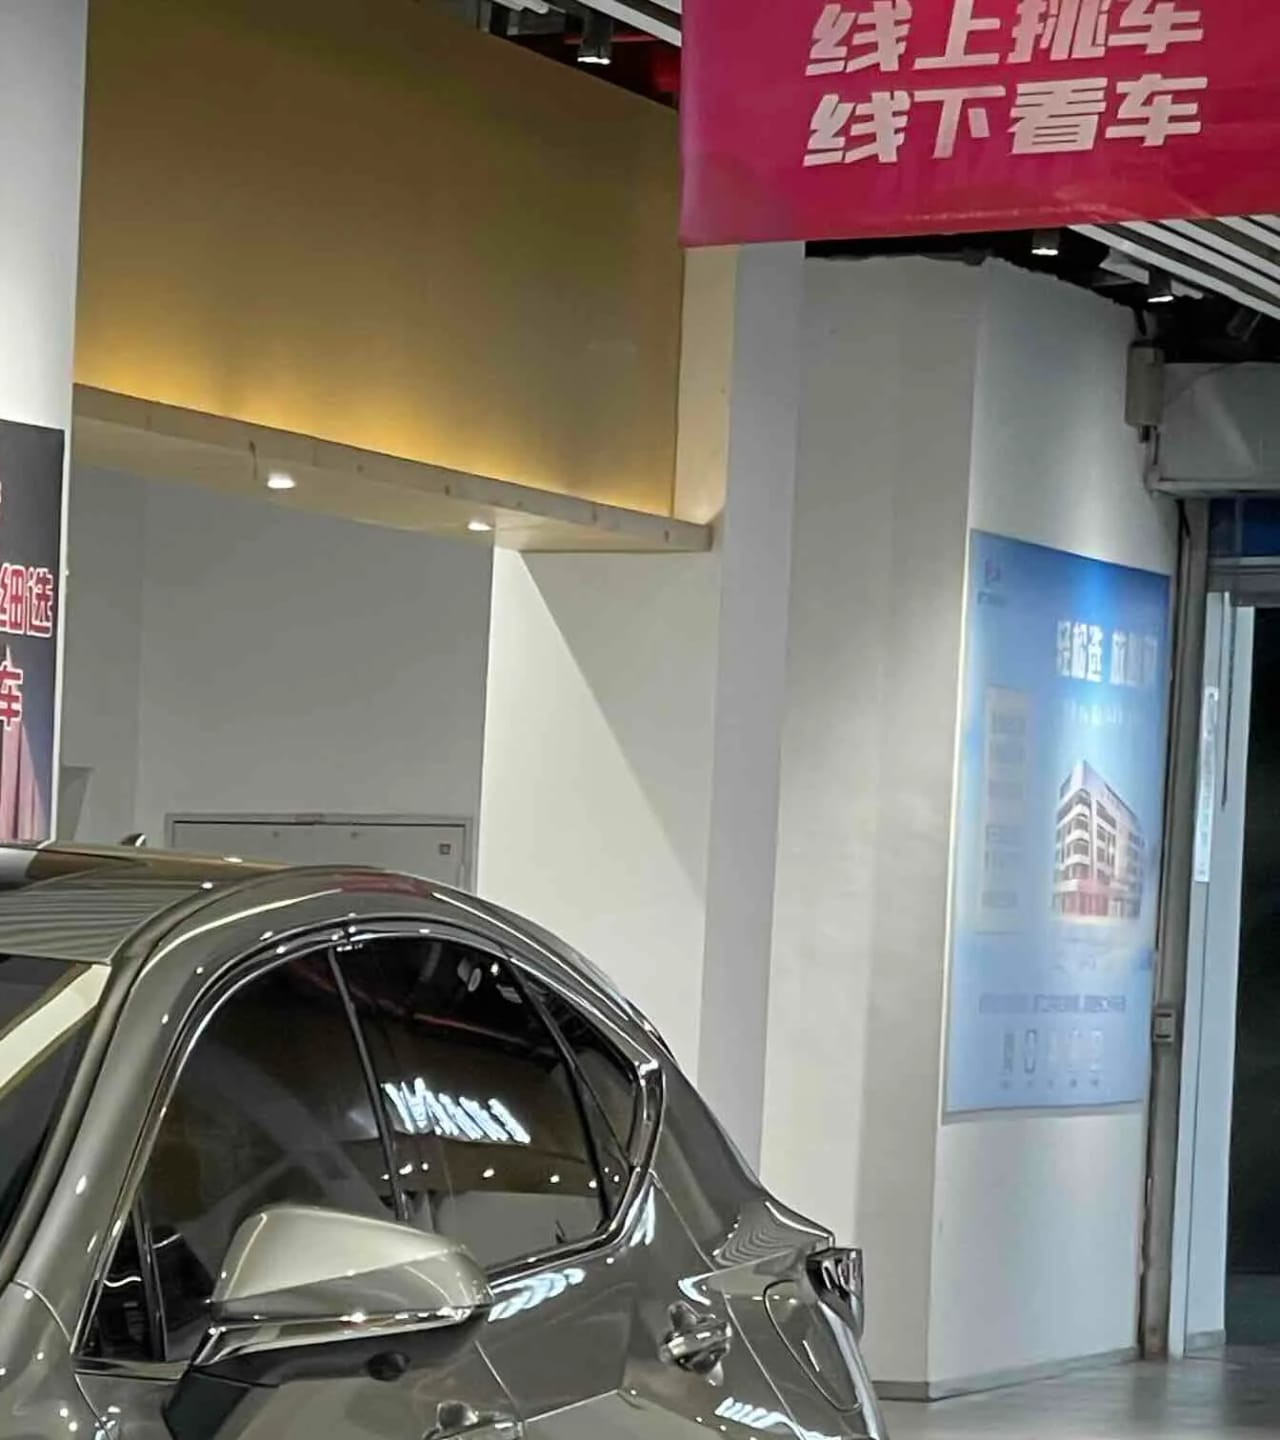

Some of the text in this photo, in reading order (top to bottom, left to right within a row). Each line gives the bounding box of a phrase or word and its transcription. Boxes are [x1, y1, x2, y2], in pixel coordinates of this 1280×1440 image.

[804, 0, 1204, 76] 线上挑车
[802, 73, 1208, 167] 线下看车
